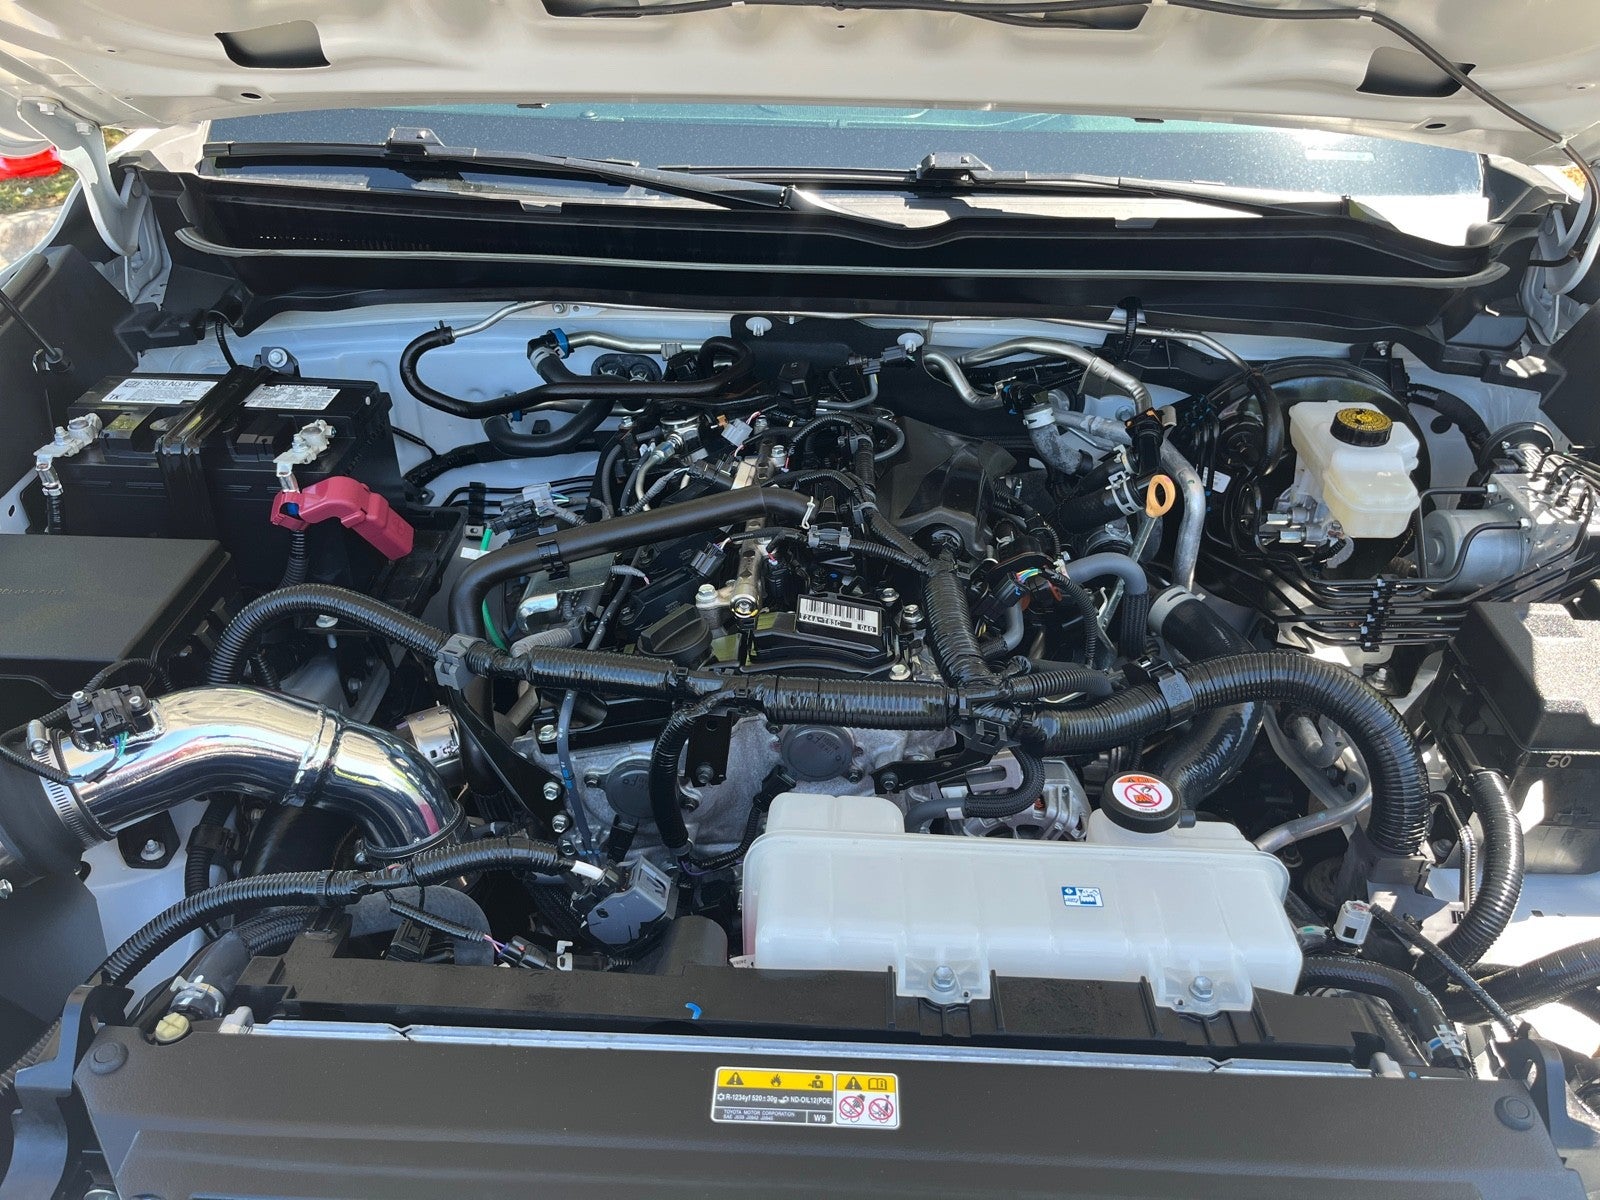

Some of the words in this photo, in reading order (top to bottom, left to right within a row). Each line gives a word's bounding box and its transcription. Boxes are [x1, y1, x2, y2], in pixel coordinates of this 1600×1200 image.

[1546, 754, 1572, 768] 50
[725, 1093, 751, 1103] R-1234yf
[761, 1110, 796, 1118] CORPORATION
[813, 1113, 827, 1123] W9
